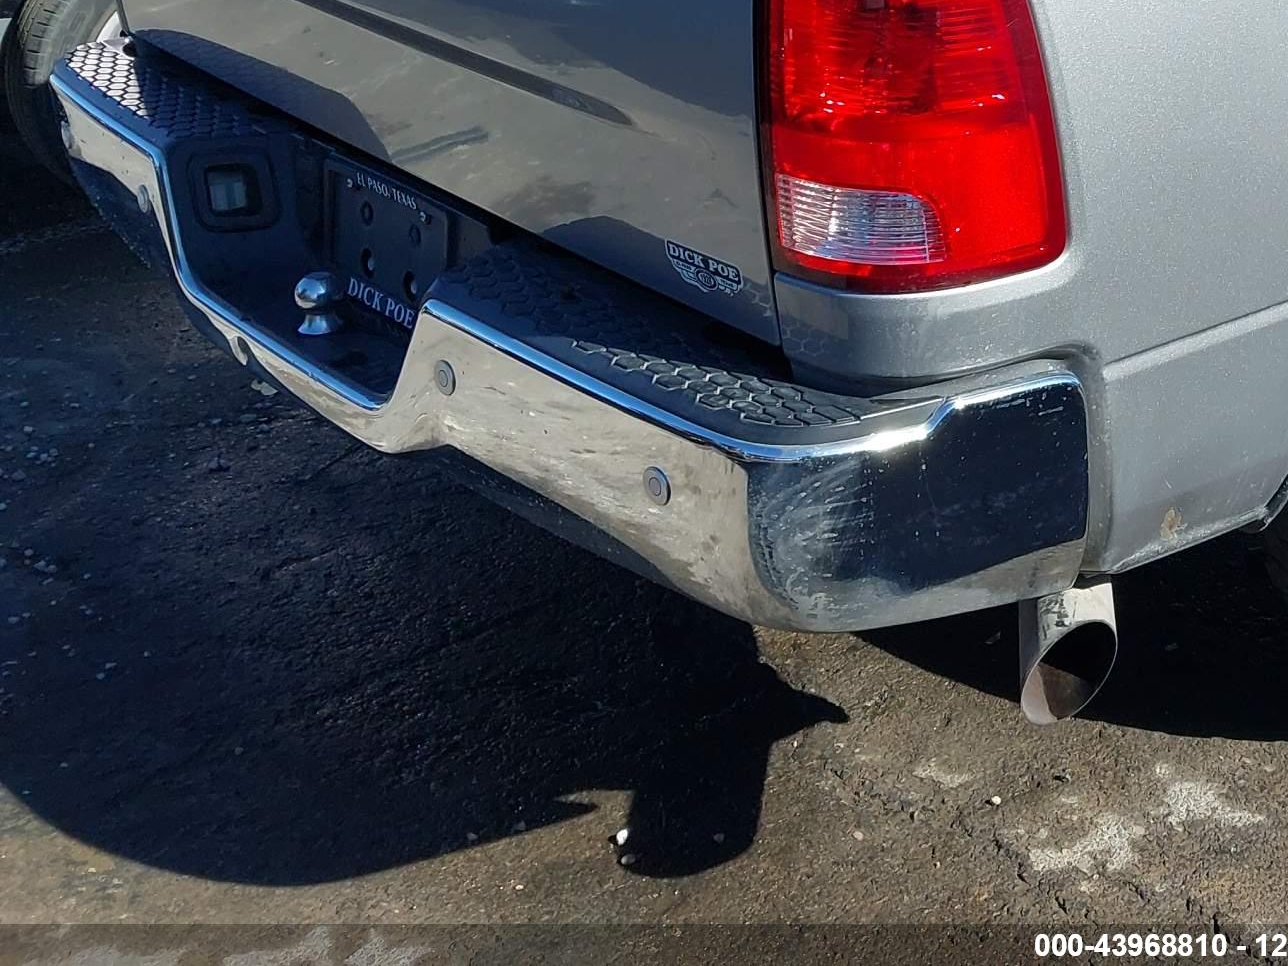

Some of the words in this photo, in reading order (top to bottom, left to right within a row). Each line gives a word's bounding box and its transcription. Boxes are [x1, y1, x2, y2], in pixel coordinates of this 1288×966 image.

[356, 172, 366, 188] EL
[391, 187, 417, 210] TEXAS
[668, 243, 706, 268] DICK
[707, 258, 740, 282] POE
[347, 277, 385, 312] DICK
[384, 297, 416, 330] POE
